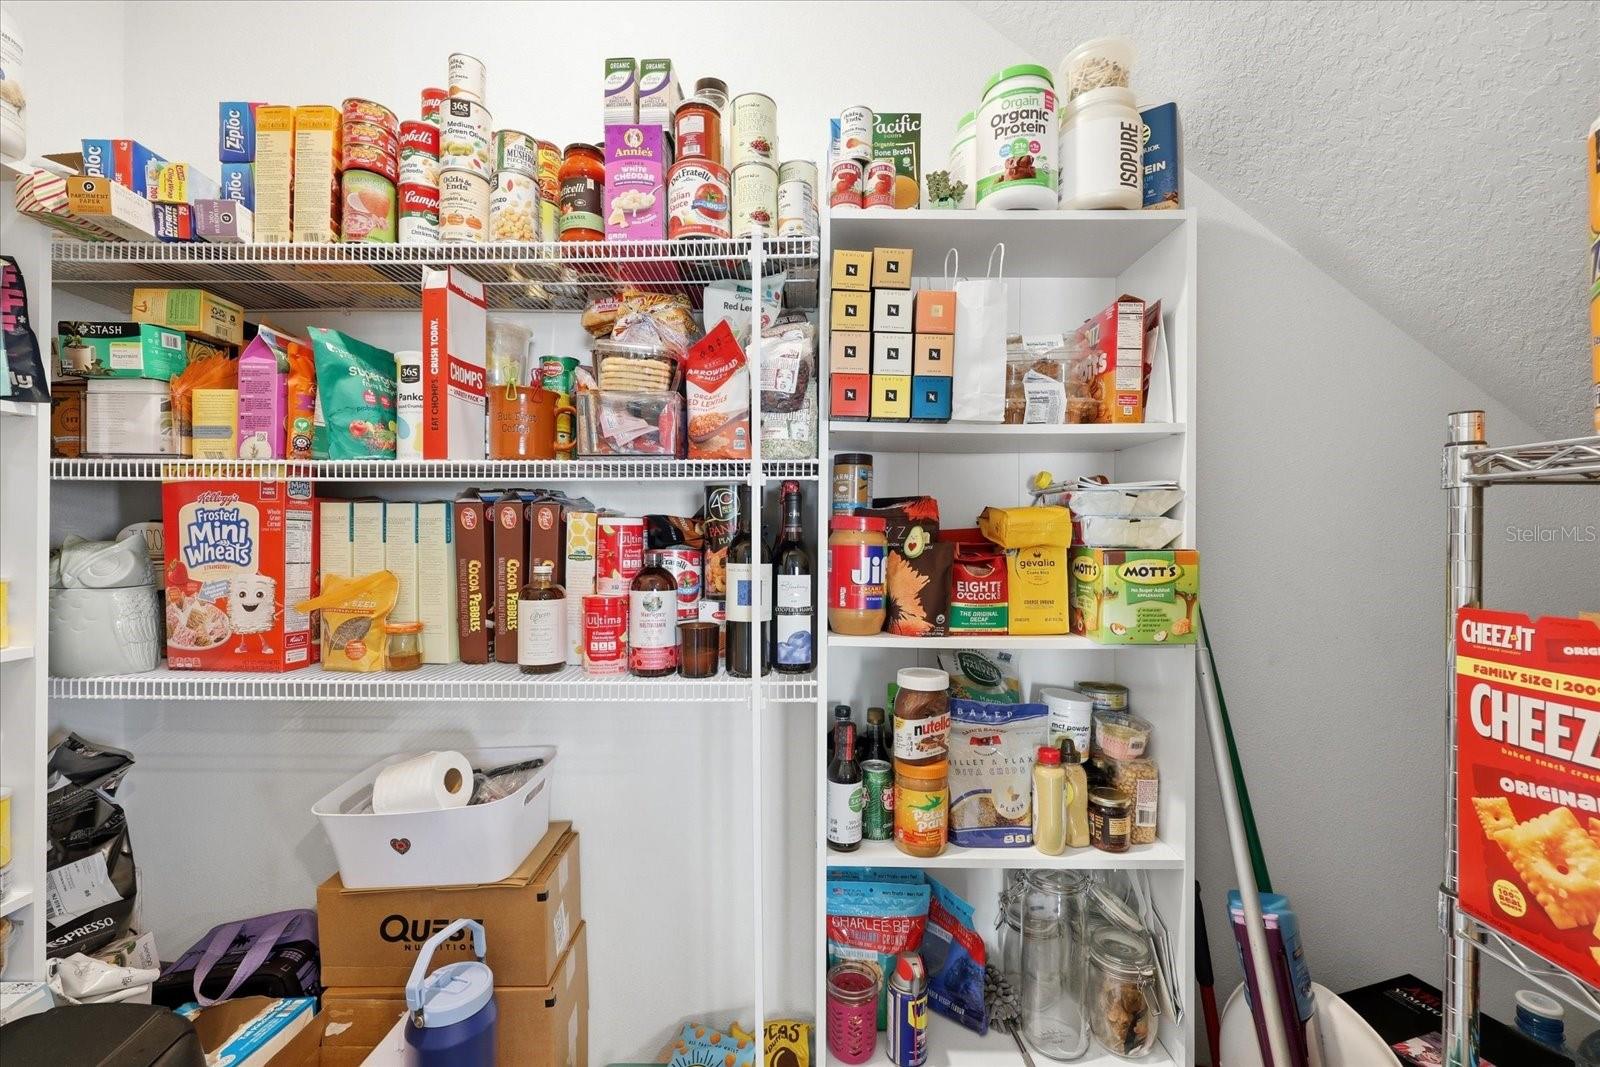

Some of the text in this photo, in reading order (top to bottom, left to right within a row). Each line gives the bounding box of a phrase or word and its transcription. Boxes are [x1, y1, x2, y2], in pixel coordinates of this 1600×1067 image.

[452, 102, 468, 112] 365
[1001, 96, 1039, 110] Orgain
[447, 121, 474, 130] Medium
[872, 114, 921, 134] Pacific
[990, 109, 1049, 128] Organic
[226, 110, 243, 149] Ziploc
[448, 127, 468, 136] Green
[994, 120, 1046, 140] Protein
[615, 147, 653, 157] Annie's
[892, 147, 912, 155] Broth
[1120, 122, 1138, 189] ISOPURE
[85, 146, 104, 178] ploc
[614, 173, 655, 181] CHEDDAR
[682, 168, 711, 182] Fratelli
[228, 172, 245, 202] ploc
[723, 302, 738, 310] Red
[90, 325, 122, 335] STASH
[430, 318, 439, 346] TODAY.
[430, 348, 439, 375] CRUSH
[687, 359, 738, 376] ARROWHEAD
[401, 368, 418, 377] 365
[450, 361, 483, 390] CHOMPS
[431, 416, 439, 431] EAT
[197, 491, 239, 506] Kellogg's
[197, 509, 238, 523] Frosted
[189, 521, 247, 546] Mini
[185, 539, 250, 567] Wheats
[1020, 559, 1055, 569] gevalia
[1073, 562, 1097, 577] MOTT'S
[1124, 566, 1176, 578] MOTT'S
[506, 558, 520, 630] COCOA PEBBLES
[957, 581, 996, 592] EIGHT
[468, 559, 482, 632] COCOA PEBBLES
[957, 592, 997, 600] O'CLOCK
[587, 615, 622, 625] Ultima
[1563, 646, 1600, 656] ORIG
[914, 712, 951, 736] nutella
[1051, 722, 1090, 732] mct powder
[1470, 683, 1600, 769] CHEEZ
[1005, 757, 1033, 765] FLAX
[1501, 747, 1600, 783] baked snack crack
[47, 916, 114, 948] ESPRESSO
